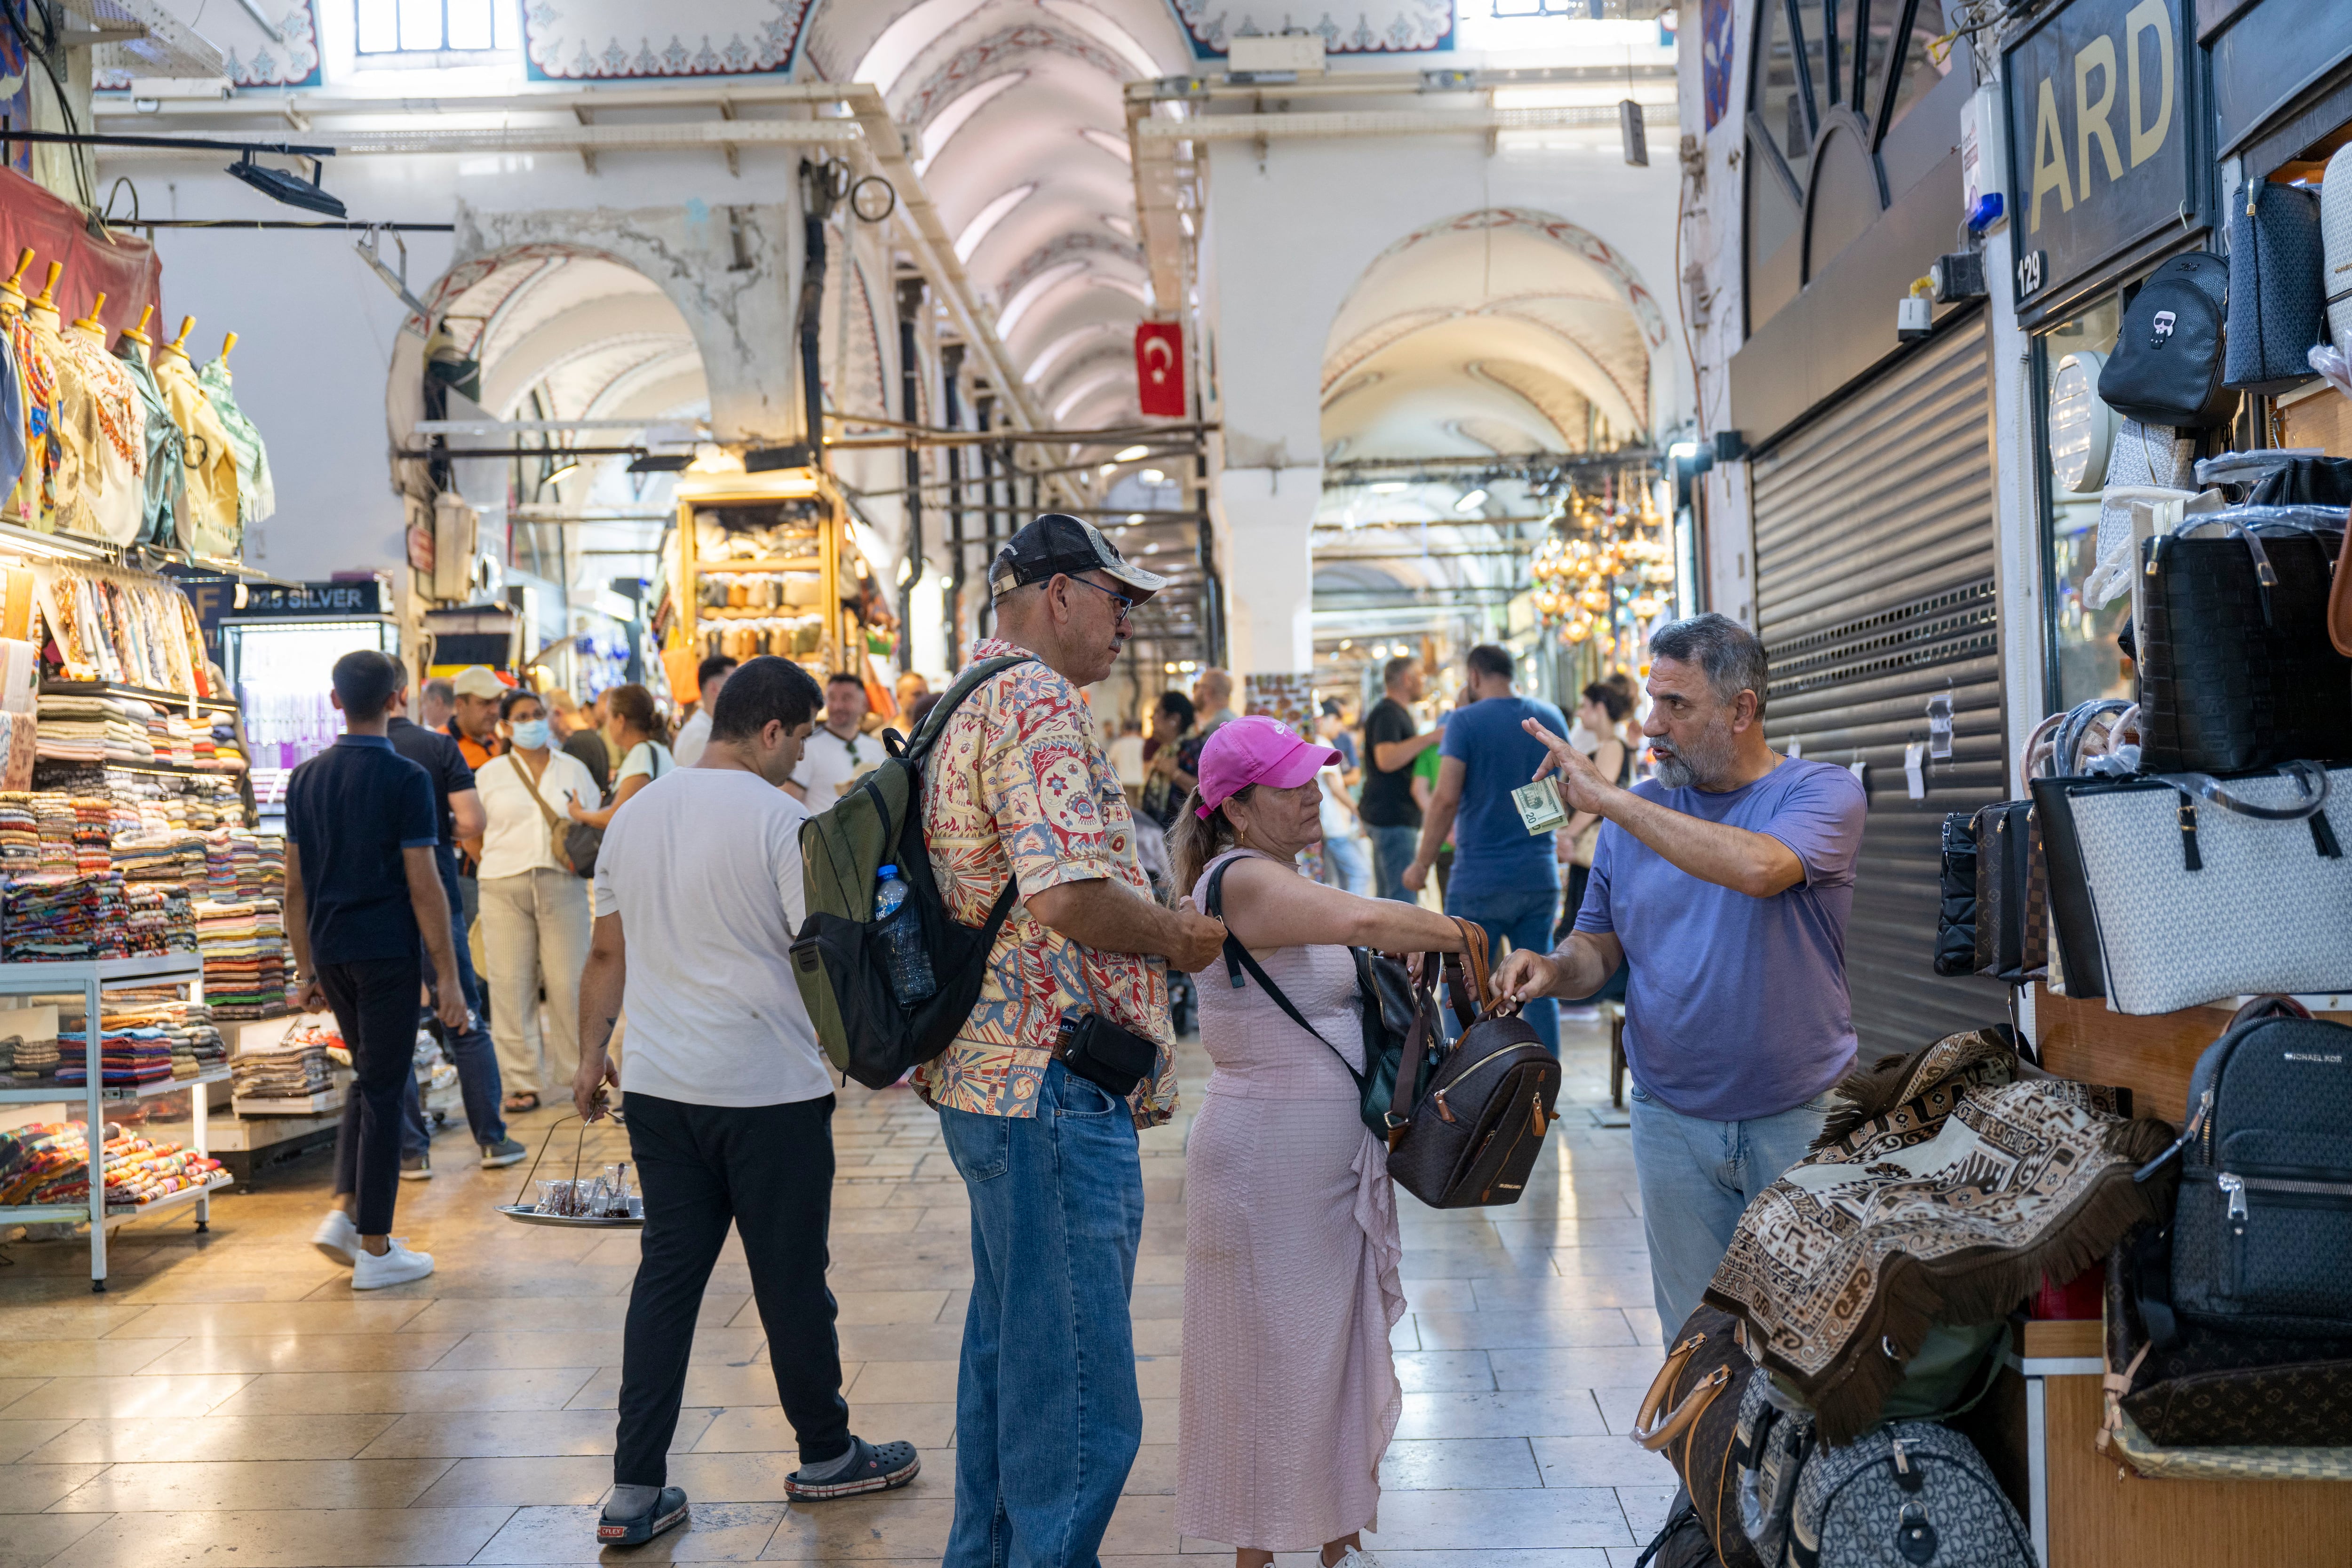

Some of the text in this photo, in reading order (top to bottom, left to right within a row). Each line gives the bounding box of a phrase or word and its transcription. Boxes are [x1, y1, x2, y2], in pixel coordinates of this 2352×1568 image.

[2031, 0, 2174, 234] ARD
[2018, 250, 2041, 297] 129
[288, 588, 364, 609] SILVER
[1526, 812, 1537, 824] 20
[2284, 1052, 2323, 1062] MICHAEL
